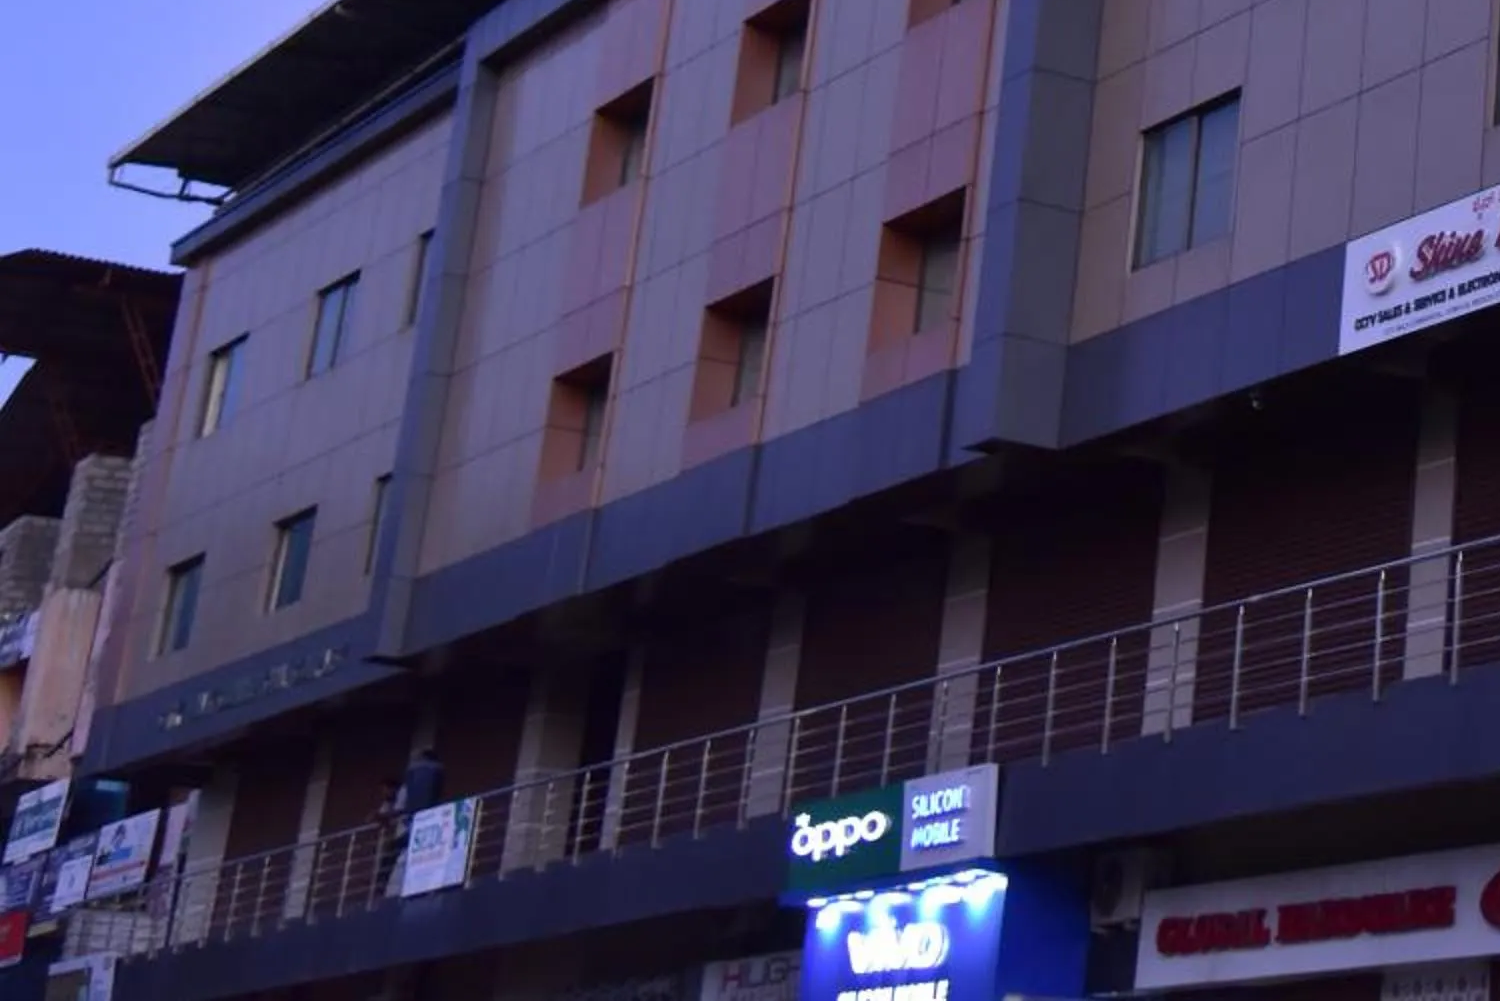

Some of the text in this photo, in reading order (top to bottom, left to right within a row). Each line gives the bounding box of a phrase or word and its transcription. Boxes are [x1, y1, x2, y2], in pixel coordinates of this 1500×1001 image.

[1409, 229, 1485, 282] Shine
[1377, 303, 1403, 324] SALES
[1413, 291, 1446, 312] SERVICE
[911, 784, 970, 819] SILICON
[791, 810, 890, 861] oppo
[910, 818, 962, 849] MOBILE
